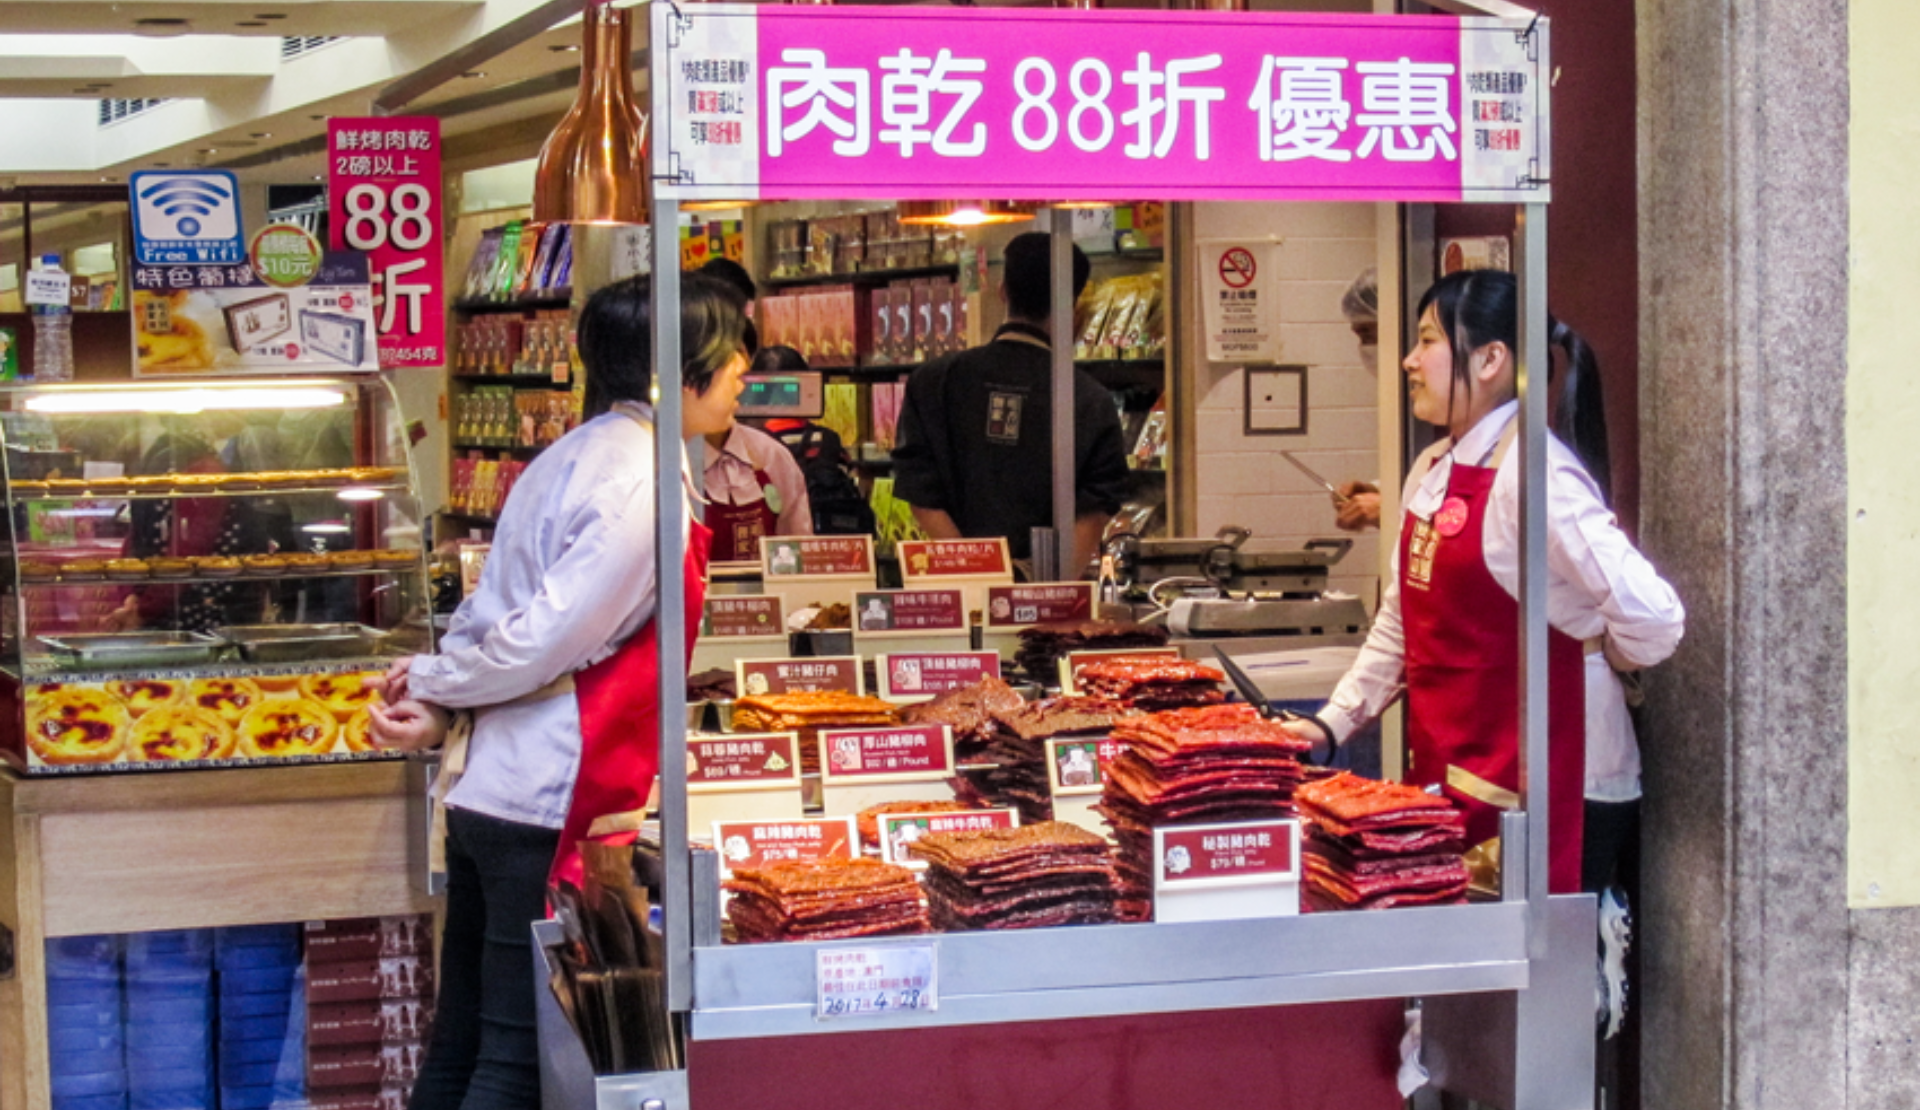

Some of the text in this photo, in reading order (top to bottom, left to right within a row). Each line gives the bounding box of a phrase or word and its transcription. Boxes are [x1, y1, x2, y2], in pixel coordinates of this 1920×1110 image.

[766, 48, 1458, 162] 肉乾 88折 優惠
[336, 129, 432, 151] 鮮烤肉乾
[336, 155, 419, 176] 2磅以上
[344, 183, 433, 251] 88
[143, 248, 239, 262] Free Wifi
[257, 256, 312, 277] $10元
